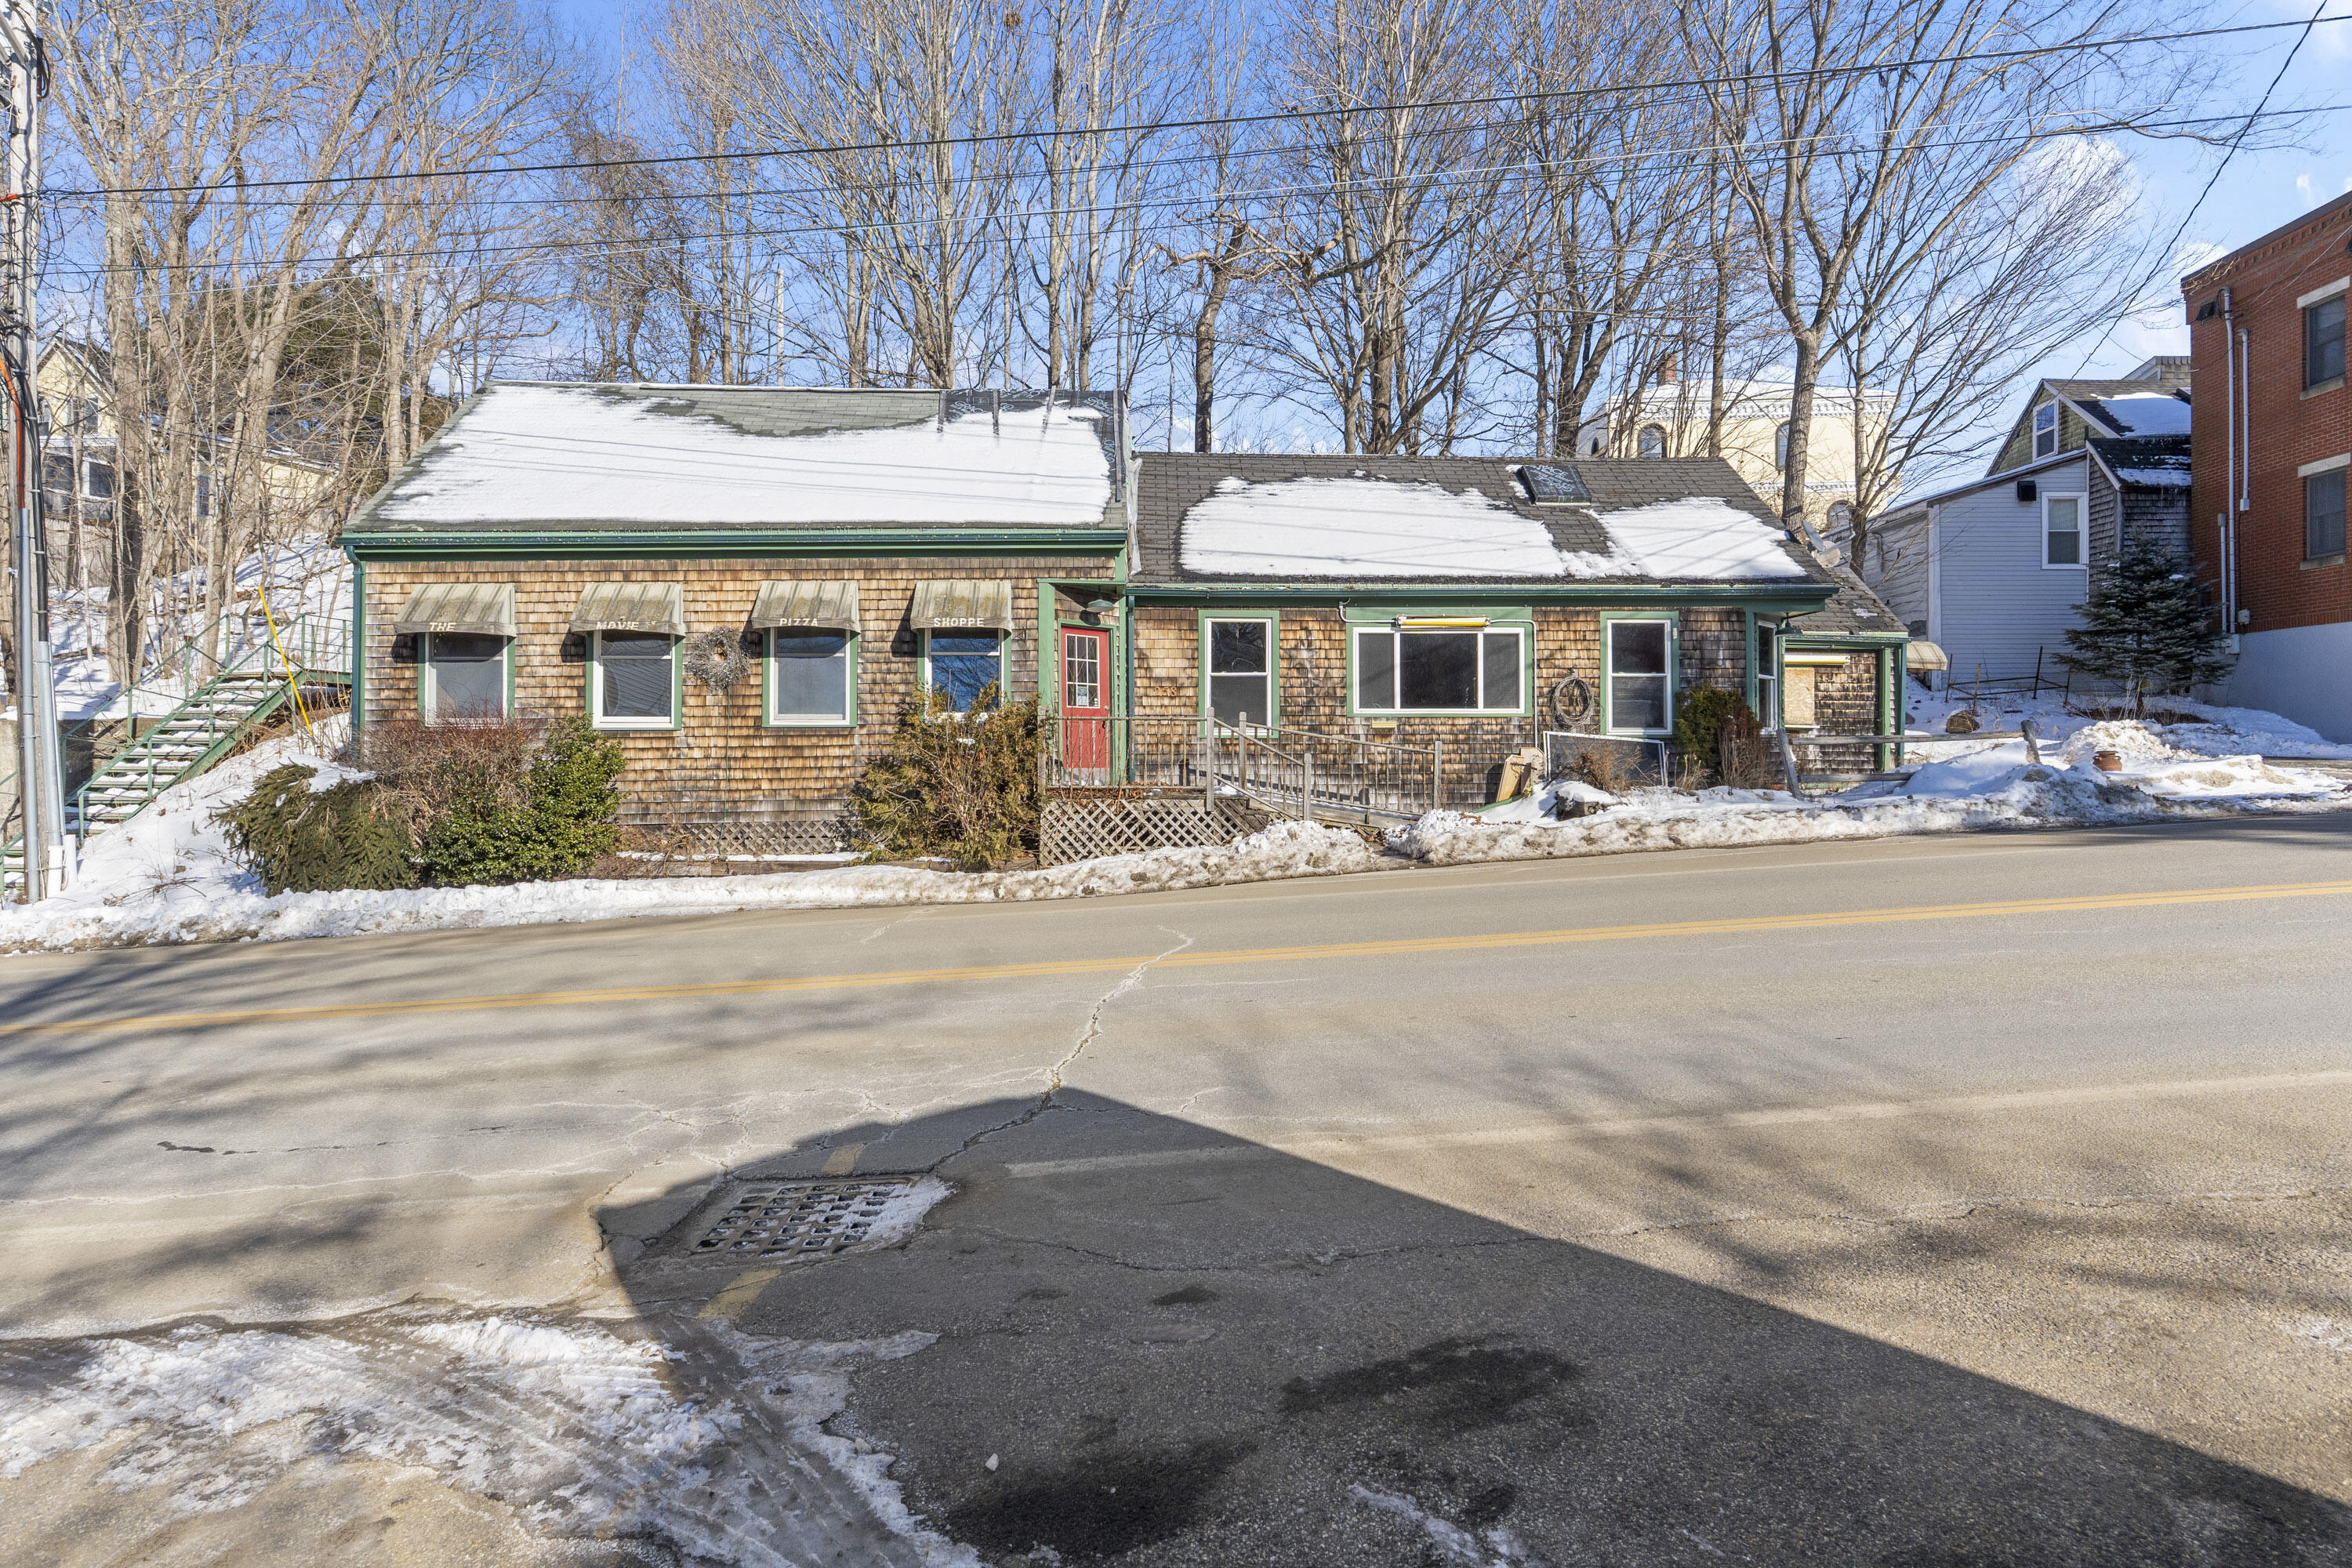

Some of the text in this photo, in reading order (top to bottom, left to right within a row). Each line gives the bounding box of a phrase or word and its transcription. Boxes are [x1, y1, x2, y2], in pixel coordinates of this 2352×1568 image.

[595, 621, 640, 630] MOVIE
[779, 618, 818, 626] PIZZA
[933, 617, 985, 627] SHOPPE
[429, 622, 457, 632] THE
